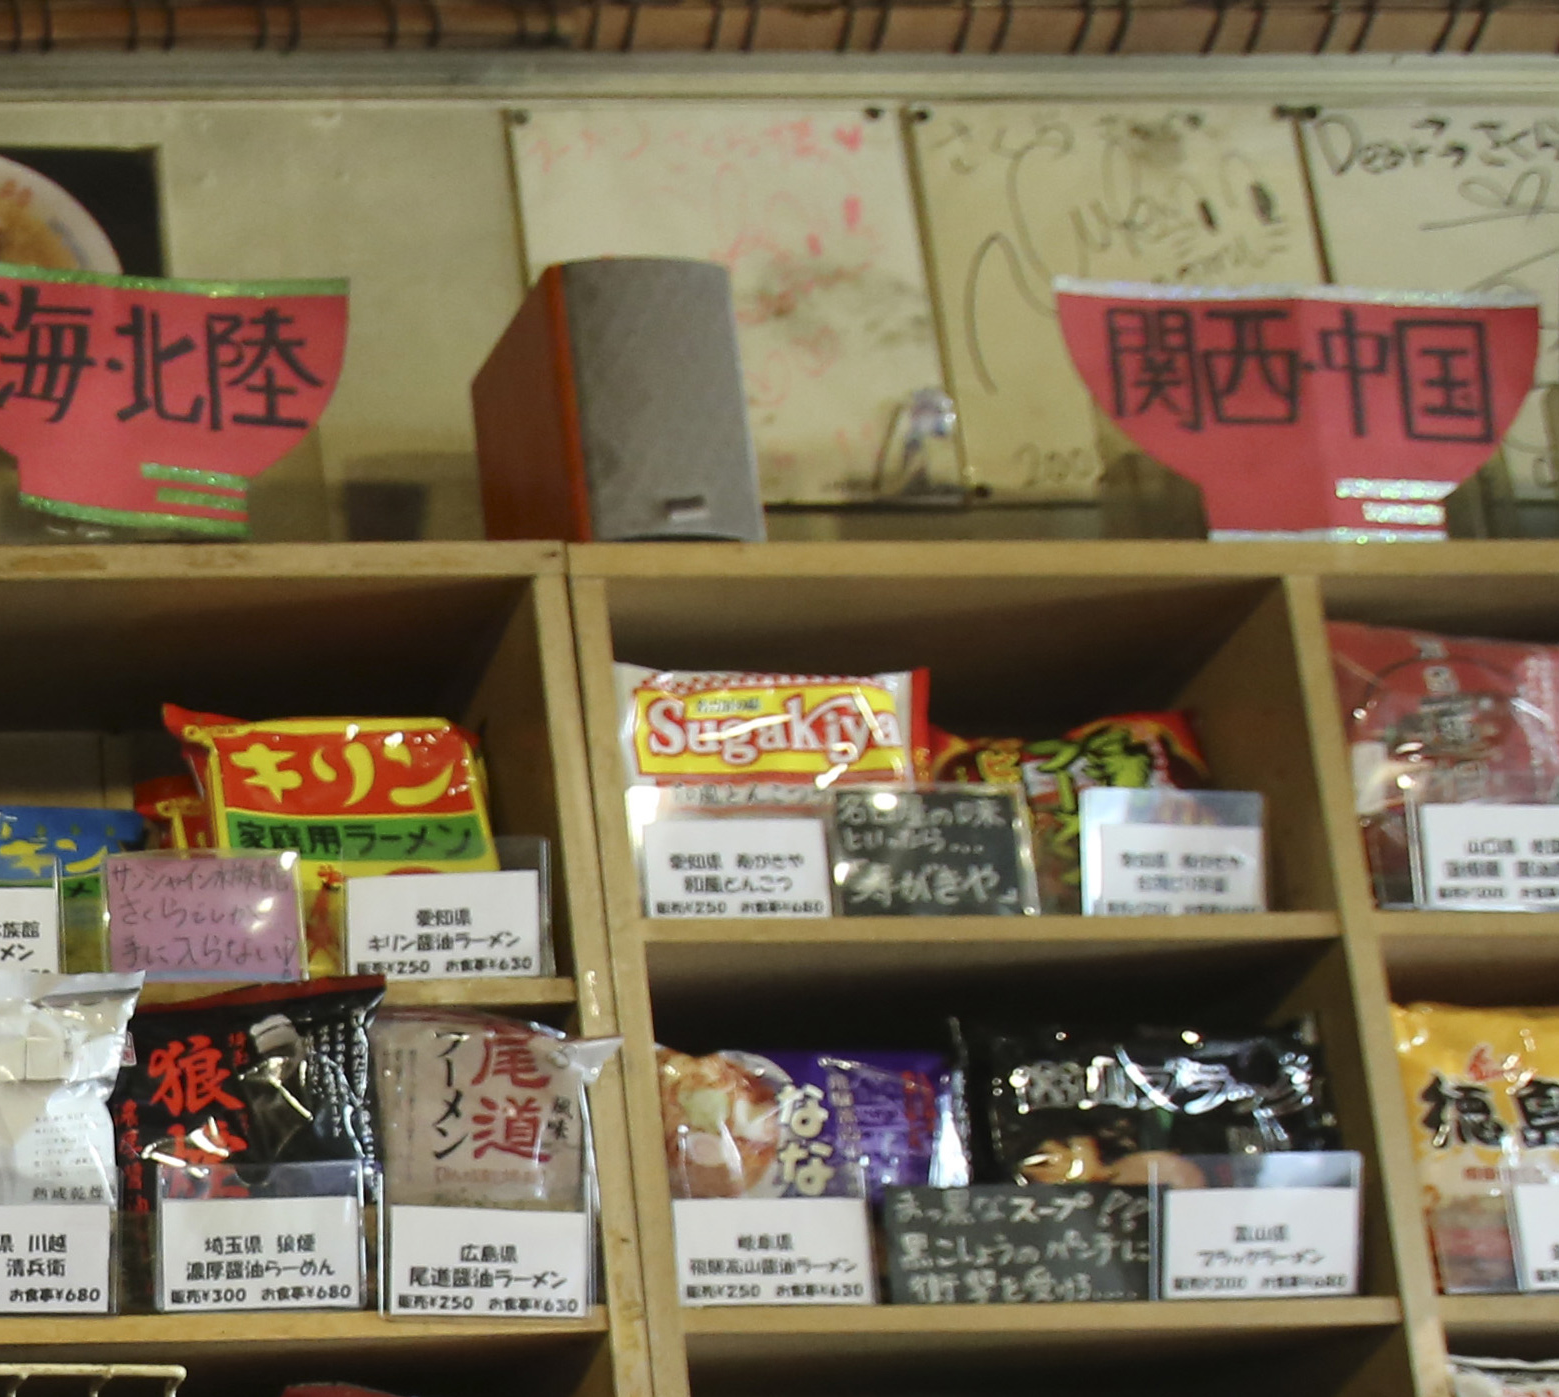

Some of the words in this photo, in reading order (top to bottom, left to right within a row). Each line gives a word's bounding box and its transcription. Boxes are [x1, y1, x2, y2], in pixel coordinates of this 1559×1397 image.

[647, 694, 903, 765] Sugakiya
[228, 734, 456, 807] キリン
[237, 820, 474, 854] 家庭用ラーメン
[685, 874, 793, 893] 和風とんこつ
[416, 908, 472, 927] 愛知県
[367, 929, 521, 954] キリン醤油ラーメン
[430, 1029, 475, 1163] ラーメン
[473, 1027, 552, 1163] 尾道
[28, 1234, 67, 1253] 川越
[203, 1234, 264, 1257] 埼玉県
[737, 1233, 795, 1251] 岐阜県
[459, 1243, 518, 1265] 広島県
[7, 1259, 65, 1277] 清兵衛
[185, 1258, 336, 1281] 濃厚醤油らーめん
[408, 1266, 568, 1290] 尾道醤油ラーメン
